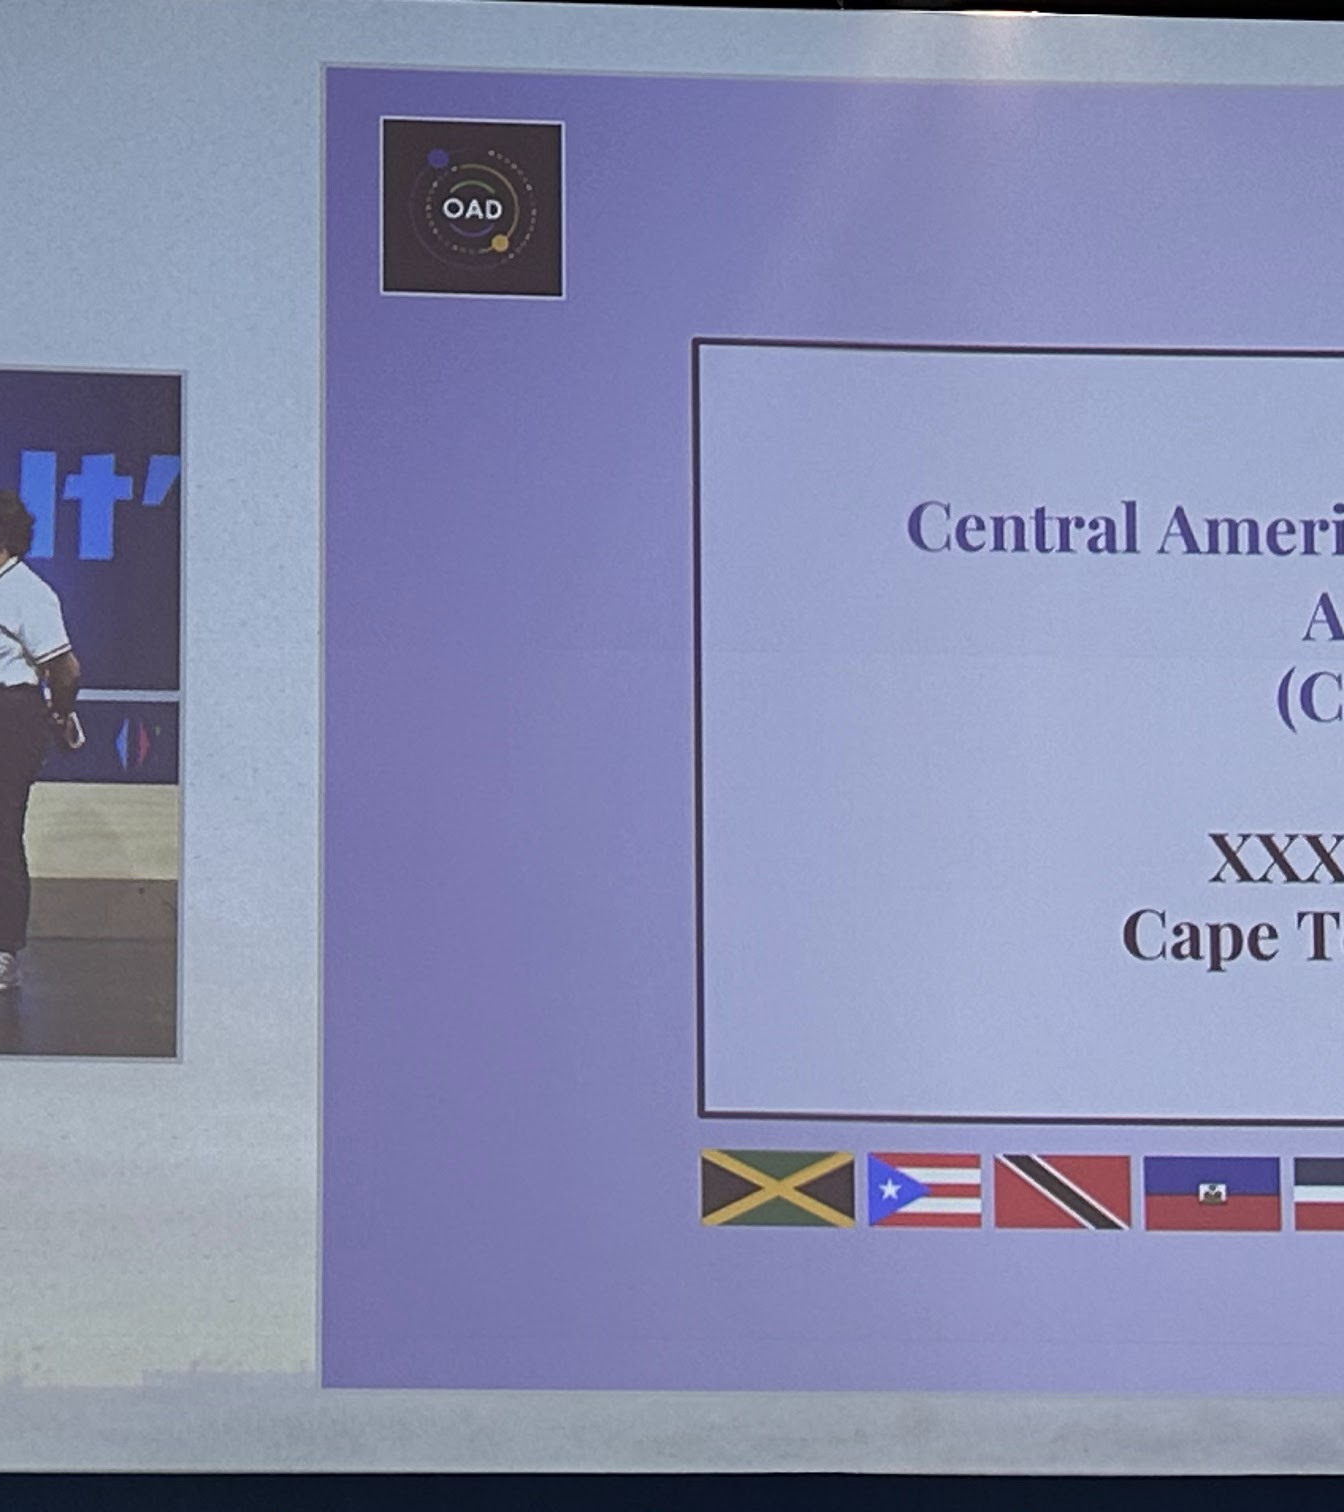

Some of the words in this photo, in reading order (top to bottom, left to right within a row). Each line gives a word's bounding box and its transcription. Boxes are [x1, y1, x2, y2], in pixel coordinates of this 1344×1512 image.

[443, 198, 503, 220] OAD
[908, 499, 1139, 556] Central
[1123, 908, 1279, 972] Cape
